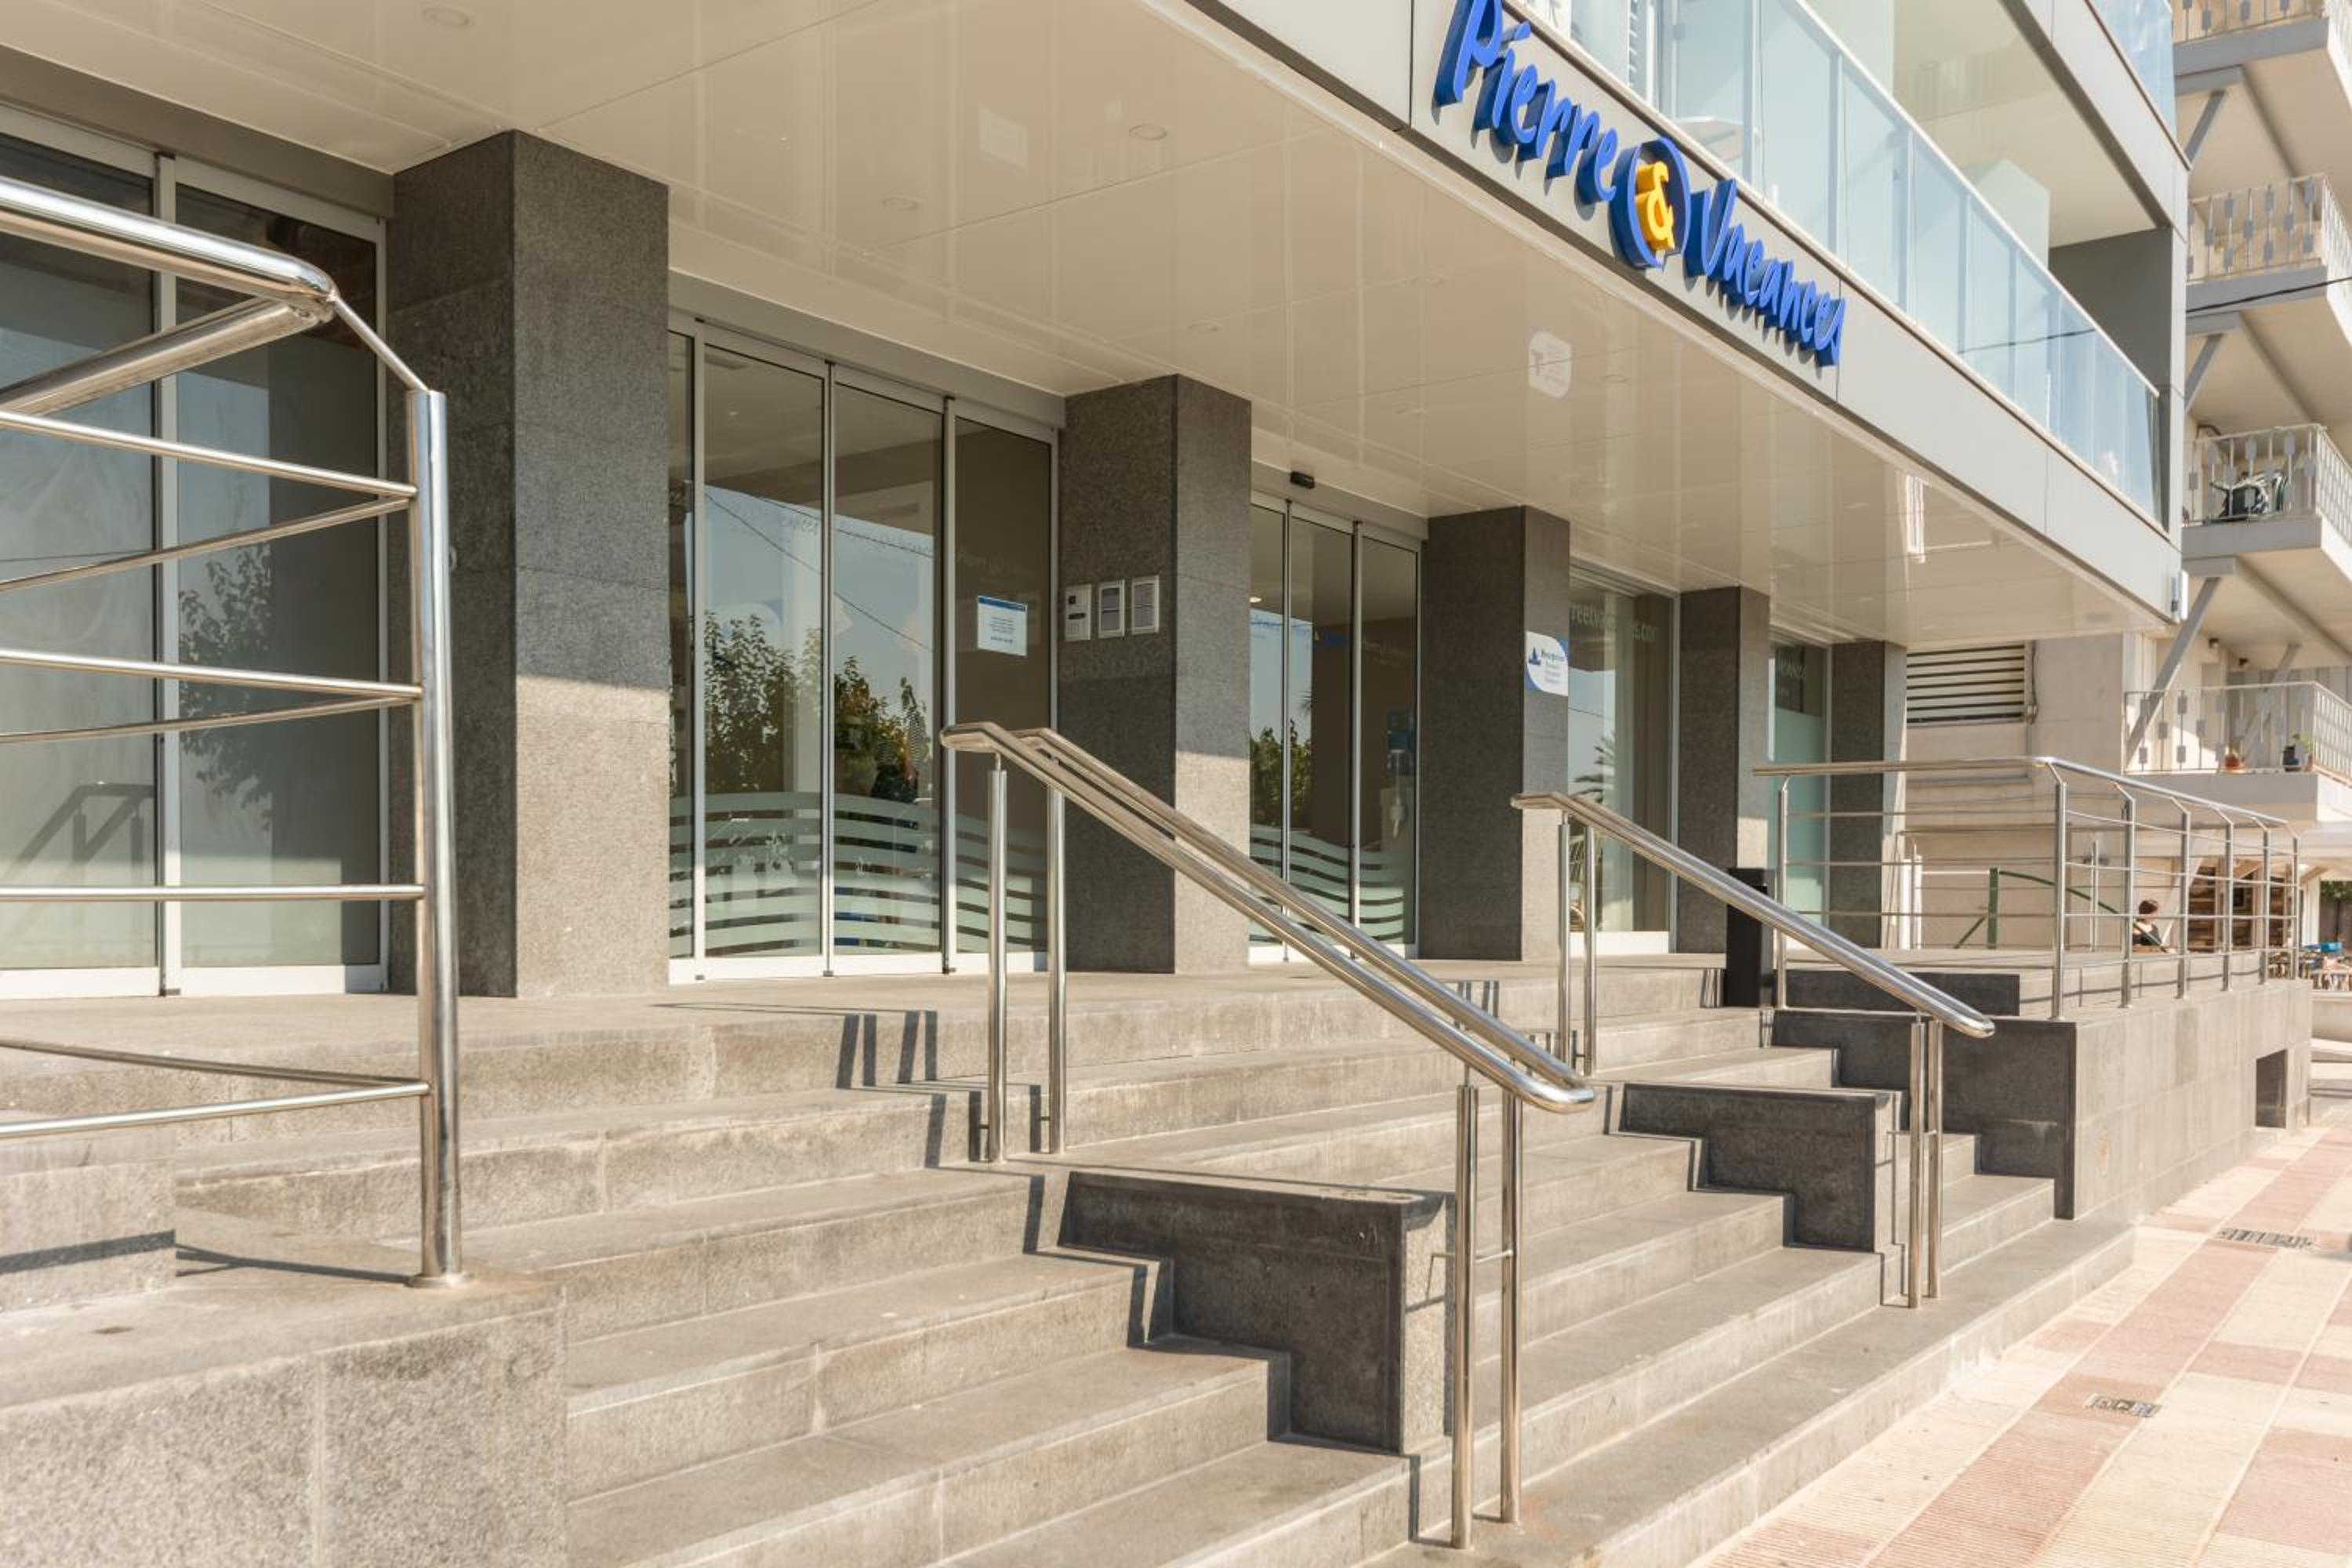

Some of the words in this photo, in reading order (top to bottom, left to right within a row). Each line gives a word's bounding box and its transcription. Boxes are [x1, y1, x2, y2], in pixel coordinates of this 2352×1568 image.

[1434, 0, 1617, 204] Pierre
[1635, 160, 1676, 254] &
[1685, 178, 1846, 367] Vacances
